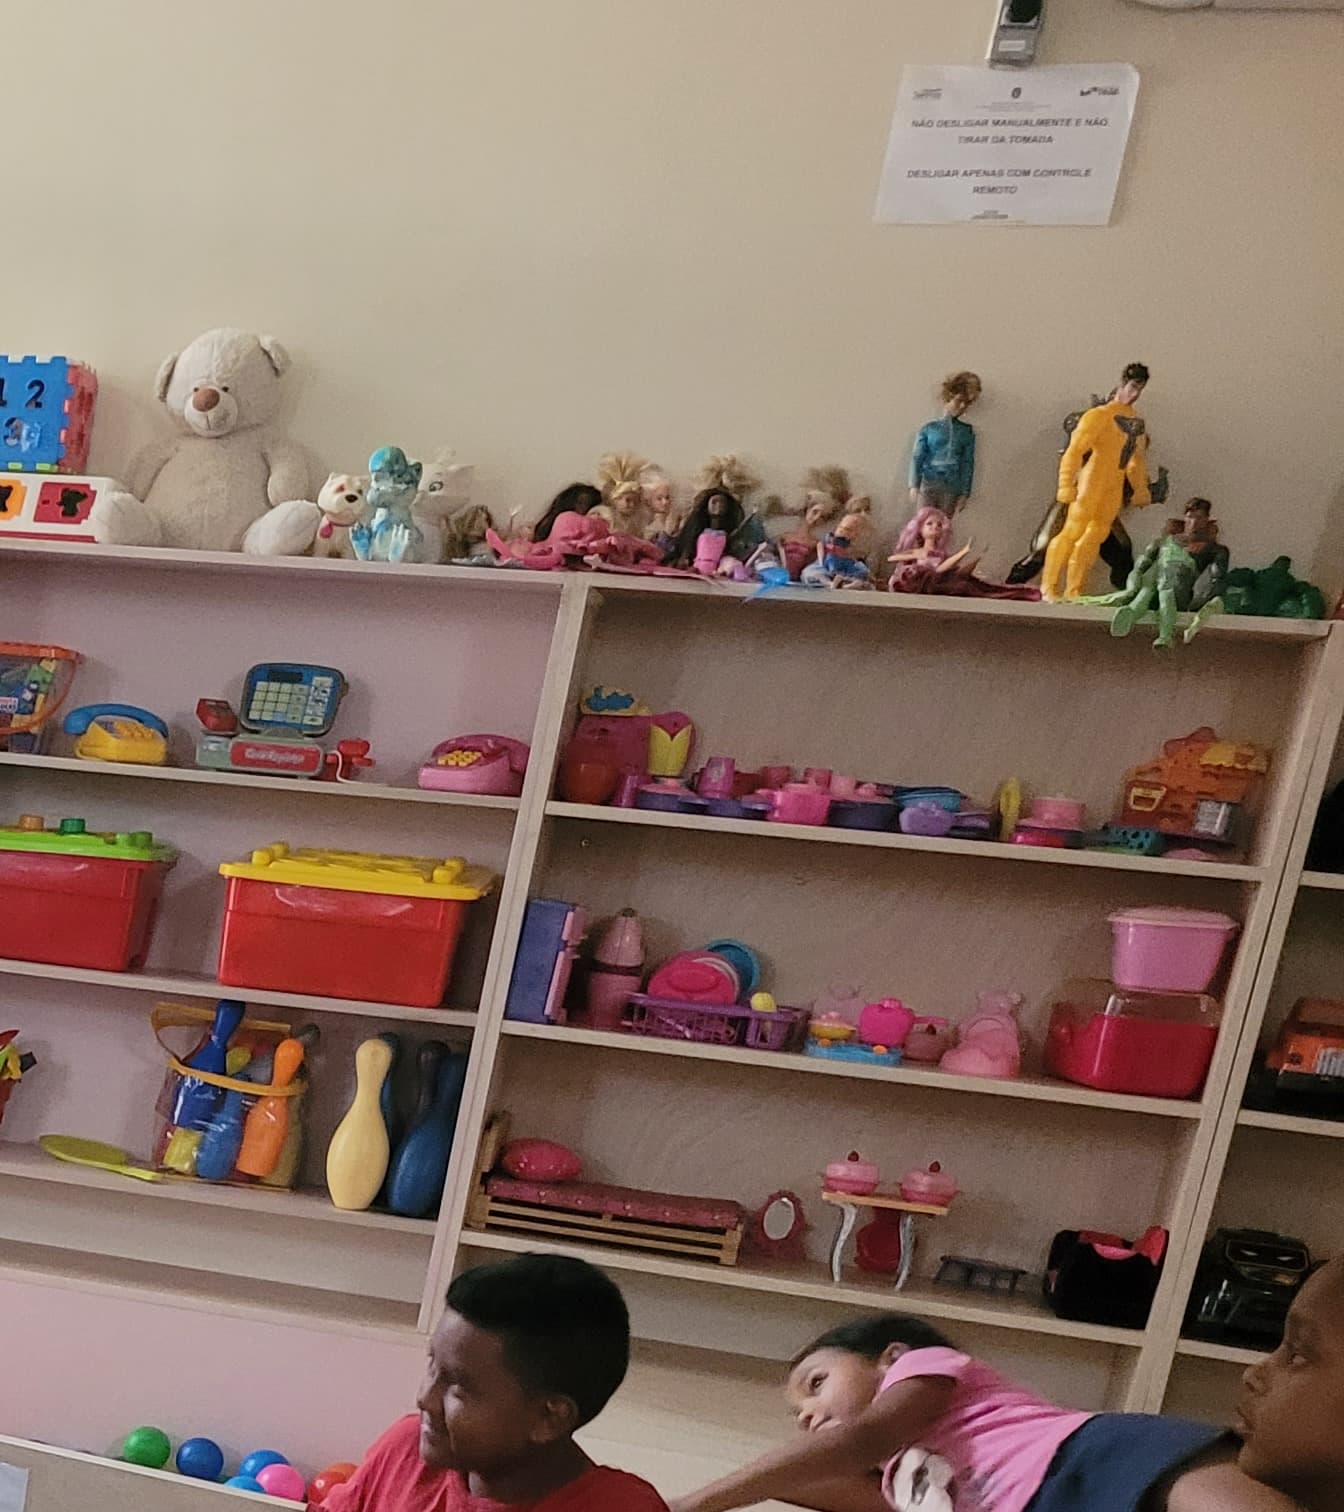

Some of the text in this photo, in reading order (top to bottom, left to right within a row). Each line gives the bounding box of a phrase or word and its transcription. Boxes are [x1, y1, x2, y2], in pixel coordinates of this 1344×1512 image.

[912, 116, 1109, 128] NÃO DESLIGAR MANUALMENTE E NÃO
[958, 135, 1054, 144] TIRAR DA TOMADA
[907, 168, 1092, 178] DESLIGAR APENAS COM CONTROLE
[972, 185, 1018, 195] REMOTO
[25, 379, 45, 408] 2
